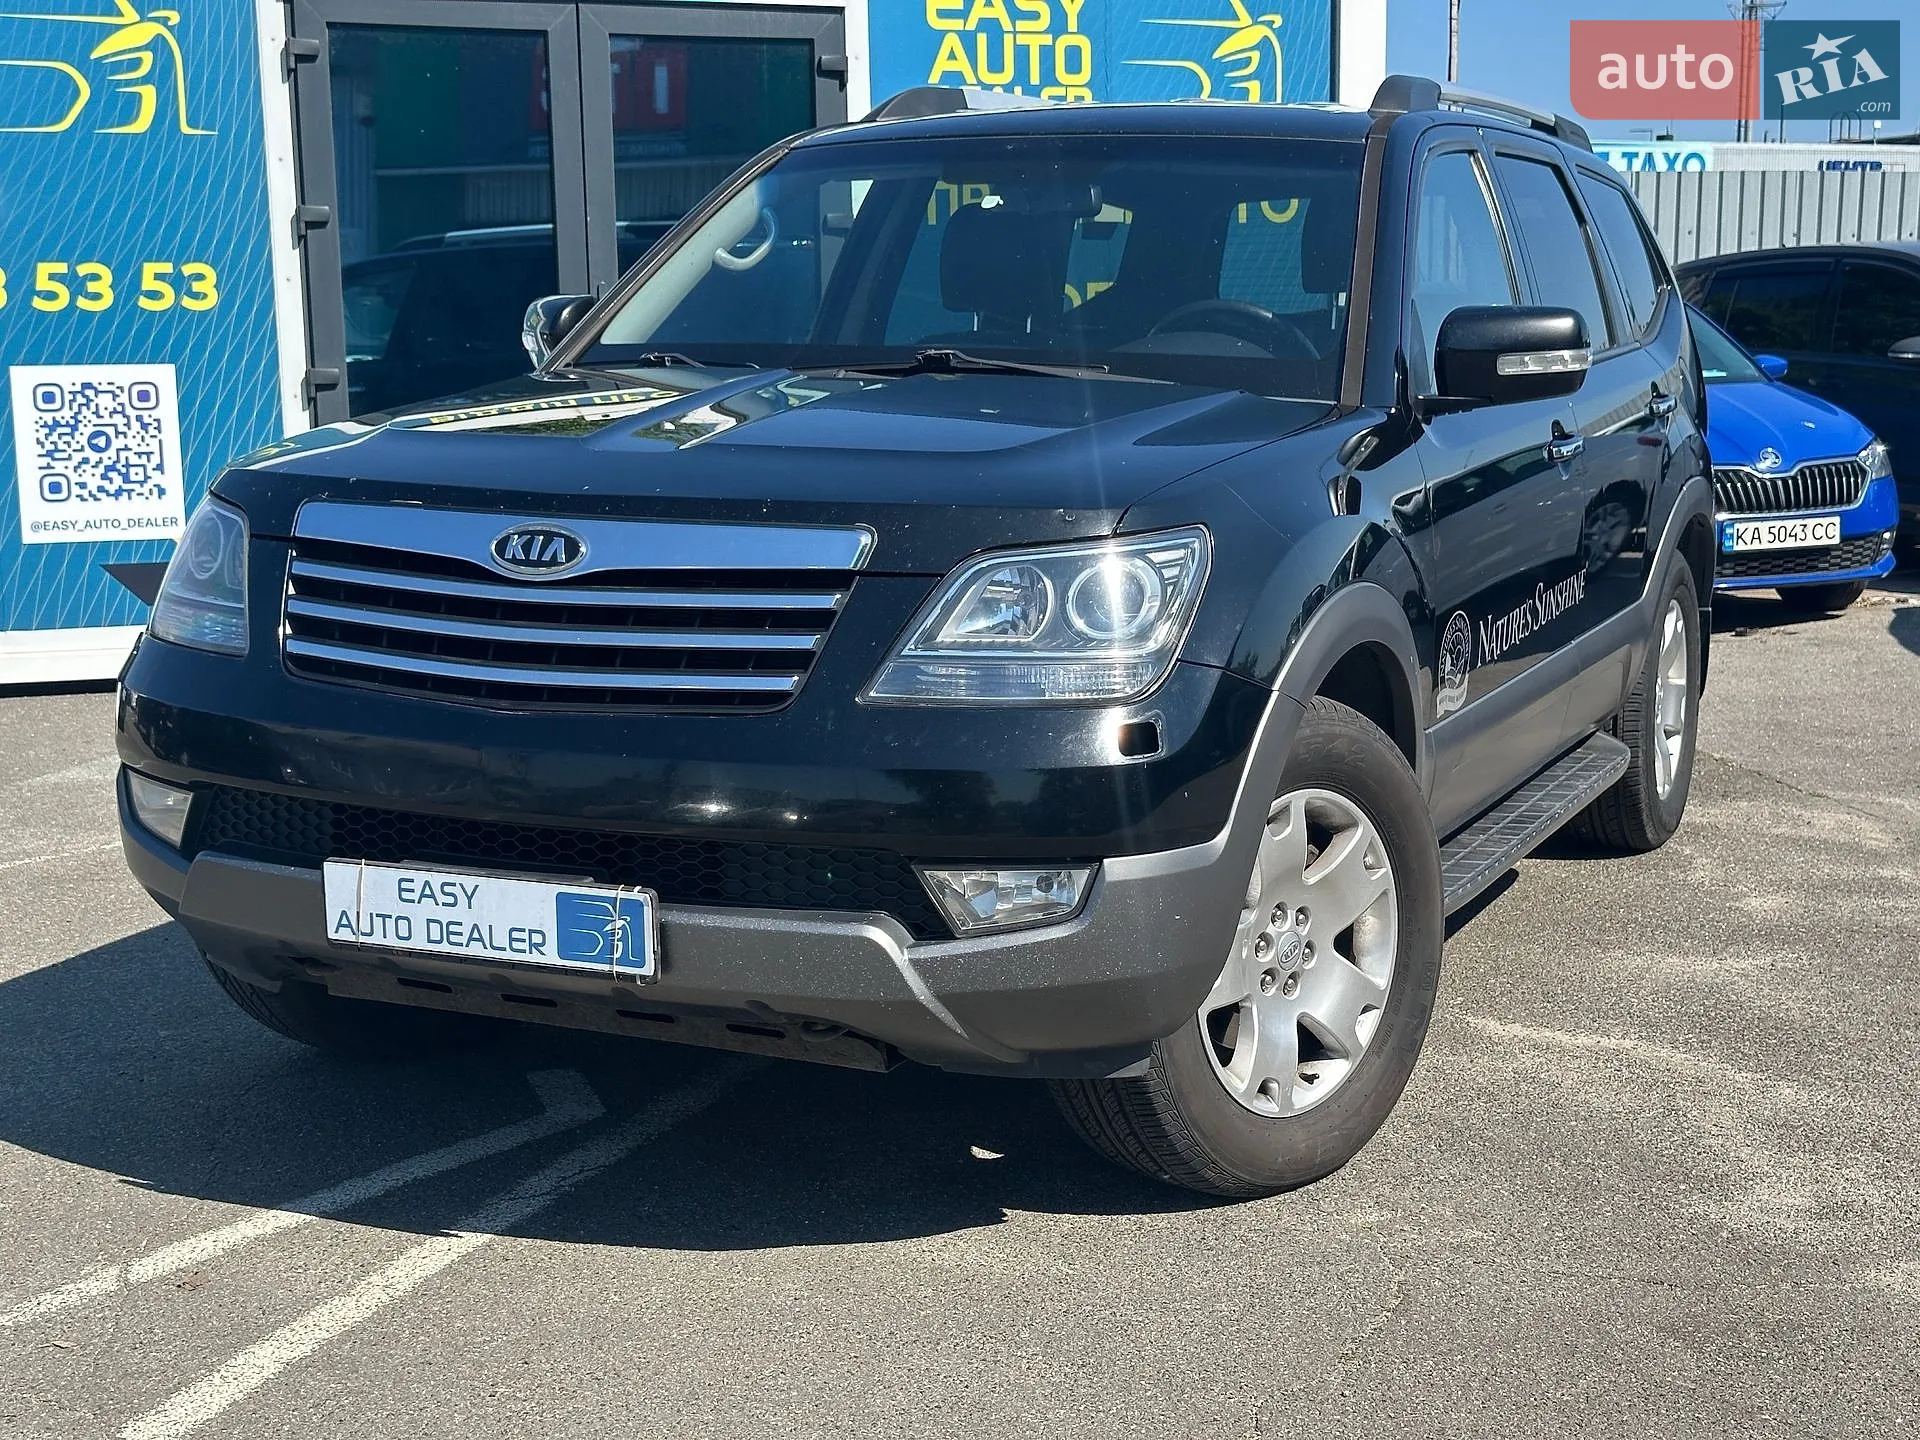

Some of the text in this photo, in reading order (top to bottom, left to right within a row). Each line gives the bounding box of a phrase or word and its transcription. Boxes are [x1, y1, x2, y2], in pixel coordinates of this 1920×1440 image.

[926, 0, 1086, 33] EASY
[927, 32, 1092, 86] AUTO
[31, 261, 115, 312] 53
[137, 261, 219, 312] 53
[30, 516, 179, 533] @EASY_AUTO_DEALER
[1735, 522, 1837, 546] KA 5043 CC
[504, 534, 567, 563] KIA
[396, 876, 480, 911] EASY
[333, 909, 547, 956] AUTO DEALER
